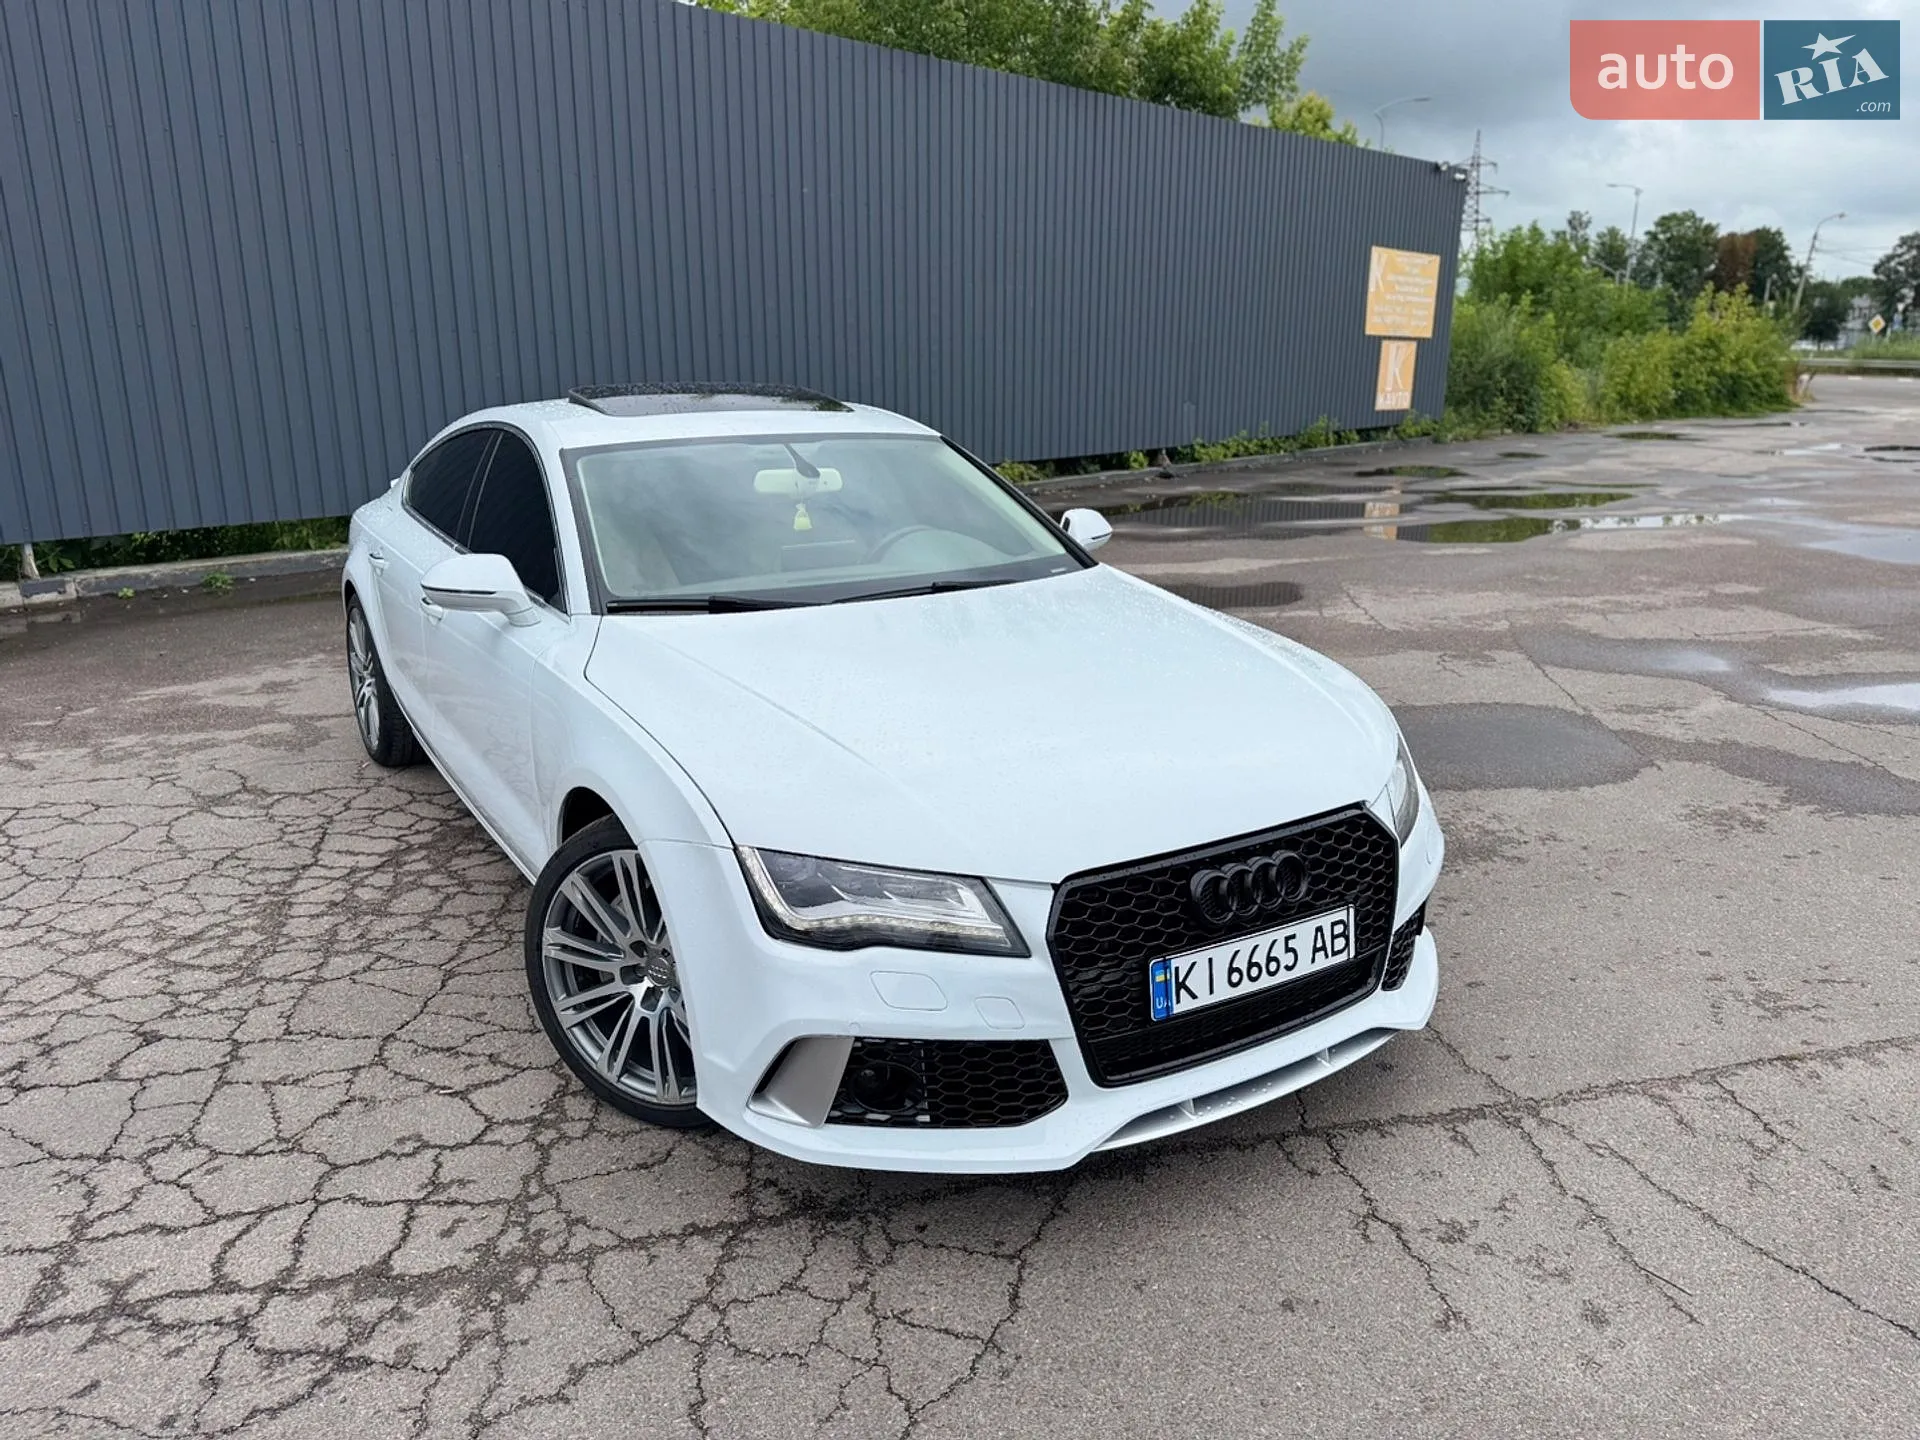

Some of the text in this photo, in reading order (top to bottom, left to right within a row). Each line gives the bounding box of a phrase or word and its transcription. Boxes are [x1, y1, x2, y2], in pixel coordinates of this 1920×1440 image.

[1174, 919, 1349, 1005] KI 6665 AB
